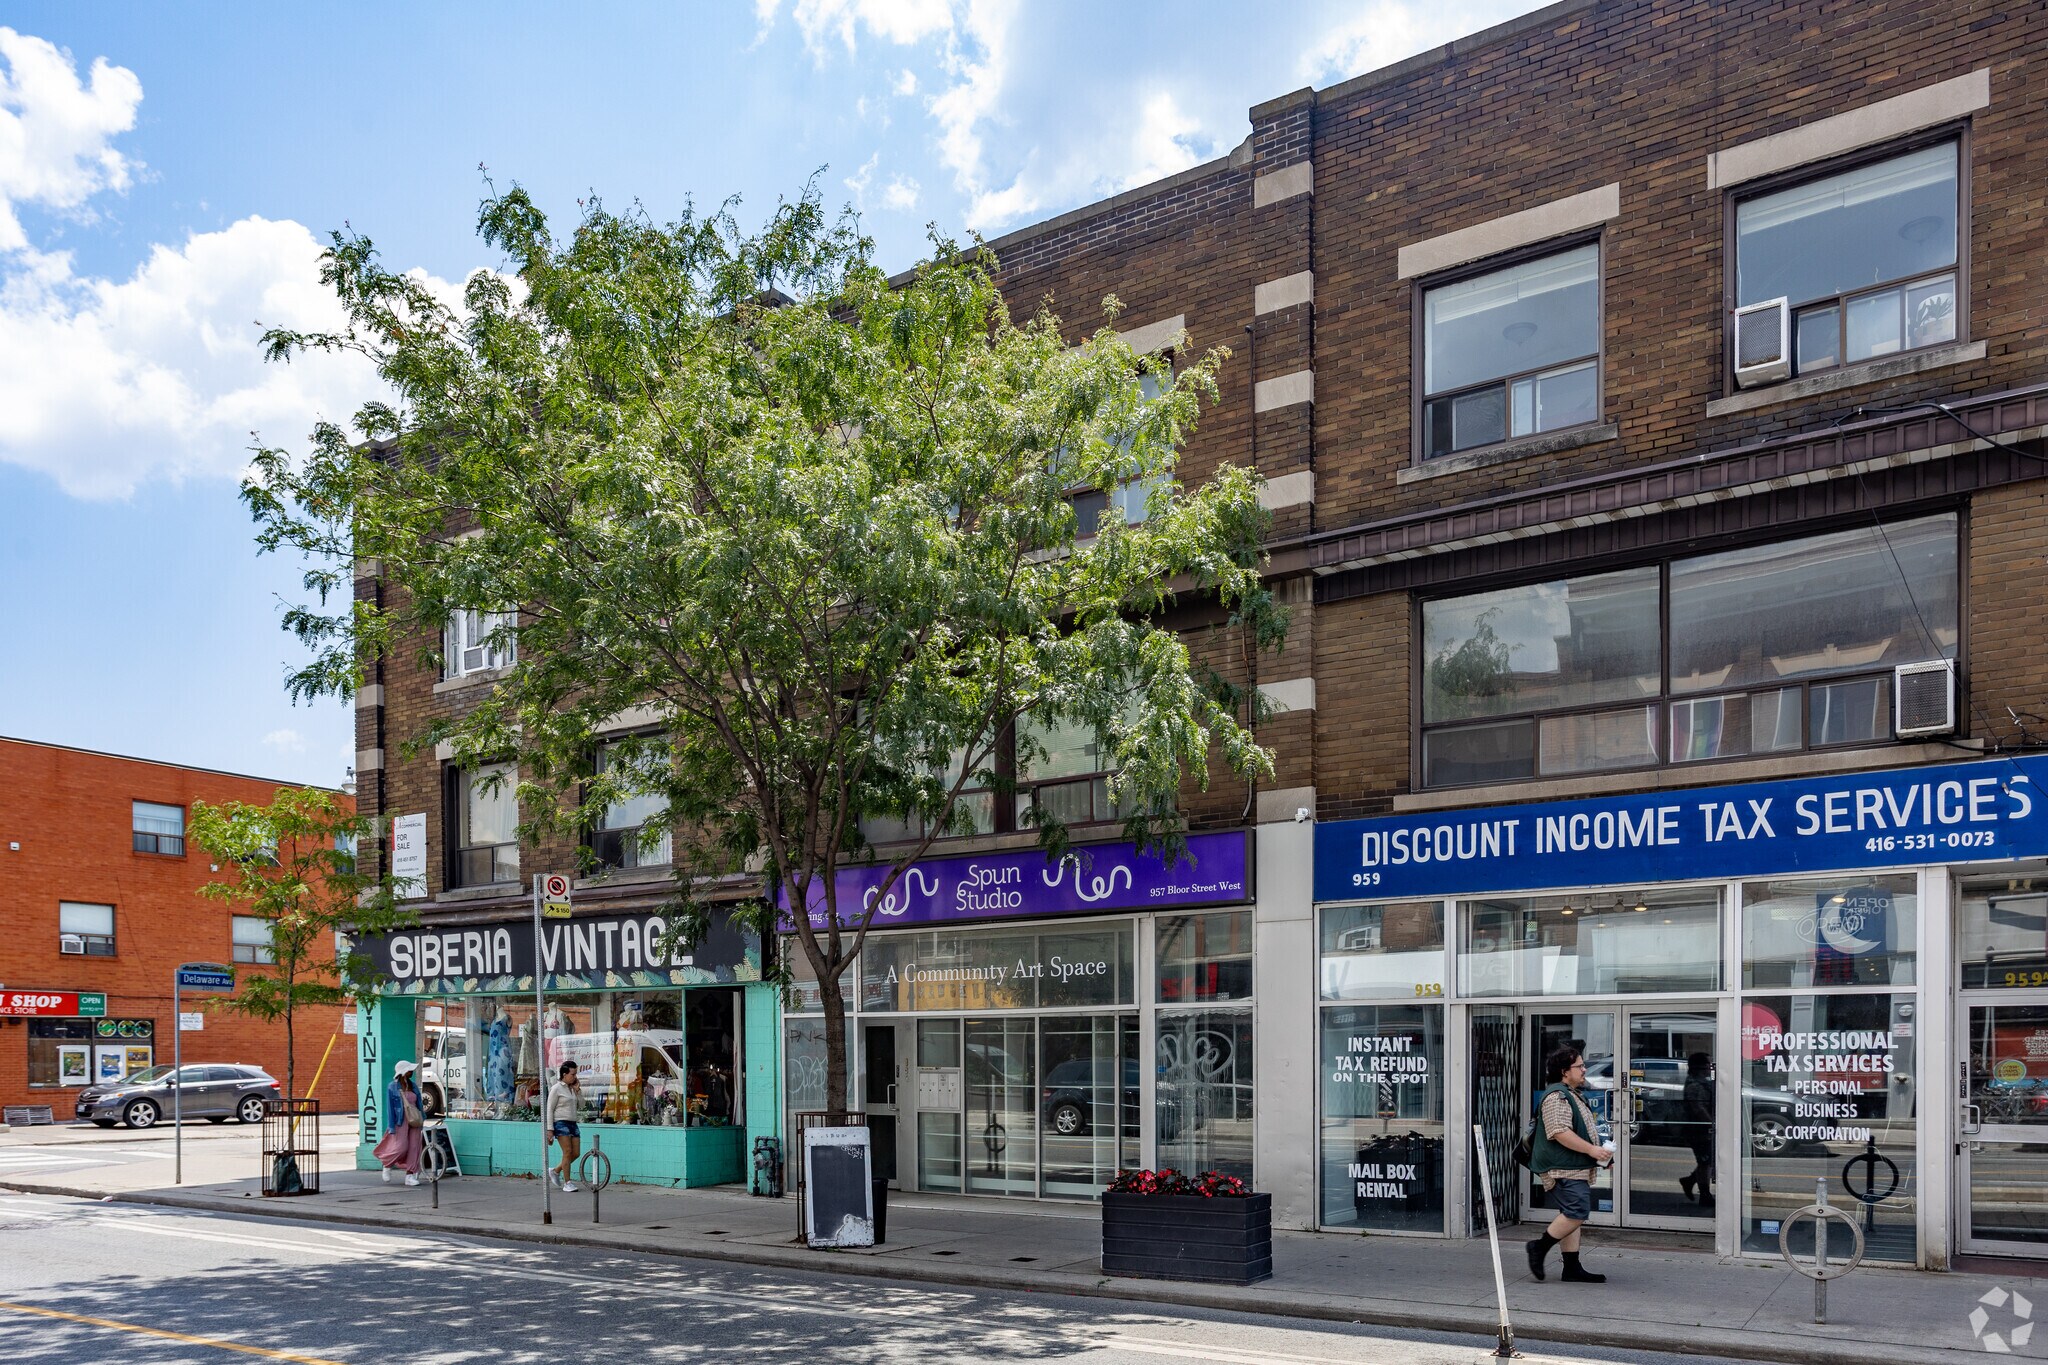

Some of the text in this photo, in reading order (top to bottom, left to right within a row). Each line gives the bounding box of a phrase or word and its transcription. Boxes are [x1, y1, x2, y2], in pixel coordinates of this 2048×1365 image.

[1362, 775, 2032, 867] DISCOUNT INCOME TAX SERVICES
[396, 842, 410, 851] SALE
[957, 864, 1021, 891] Spun
[1352, 872, 1381, 886] 959
[1150, 881, 1241, 897] 957 Bloor Street West
[956, 887, 1022, 911] Studio
[390, 928, 512, 978] SIBERIA
[183, 974, 220, 984] Delaware
[885, 956, 1107, 986] A Community Art Space
[1415, 983, 1442, 996] 959
[11, 994, 62, 1008] SHOP
[1347, 1037, 1412, 1052] INSTANT
[1758, 1032, 1899, 1050] PROFESSIONAL
[1335, 1056, 1428, 1072] TAX REFUND
[1764, 1054, 1895, 1072] TAX SERVICES
[362, 1001, 377, 1143] VINTAGE
[1332, 1073, 1429, 1084] ON THE SPOT
[1795, 1103, 1858, 1118] BUSINESS
[1784, 1126, 1870, 1141] CORPORATION
[1348, 1163, 1416, 1180] MAIL BOX
[1357, 1182, 1407, 1198] RENTAL
